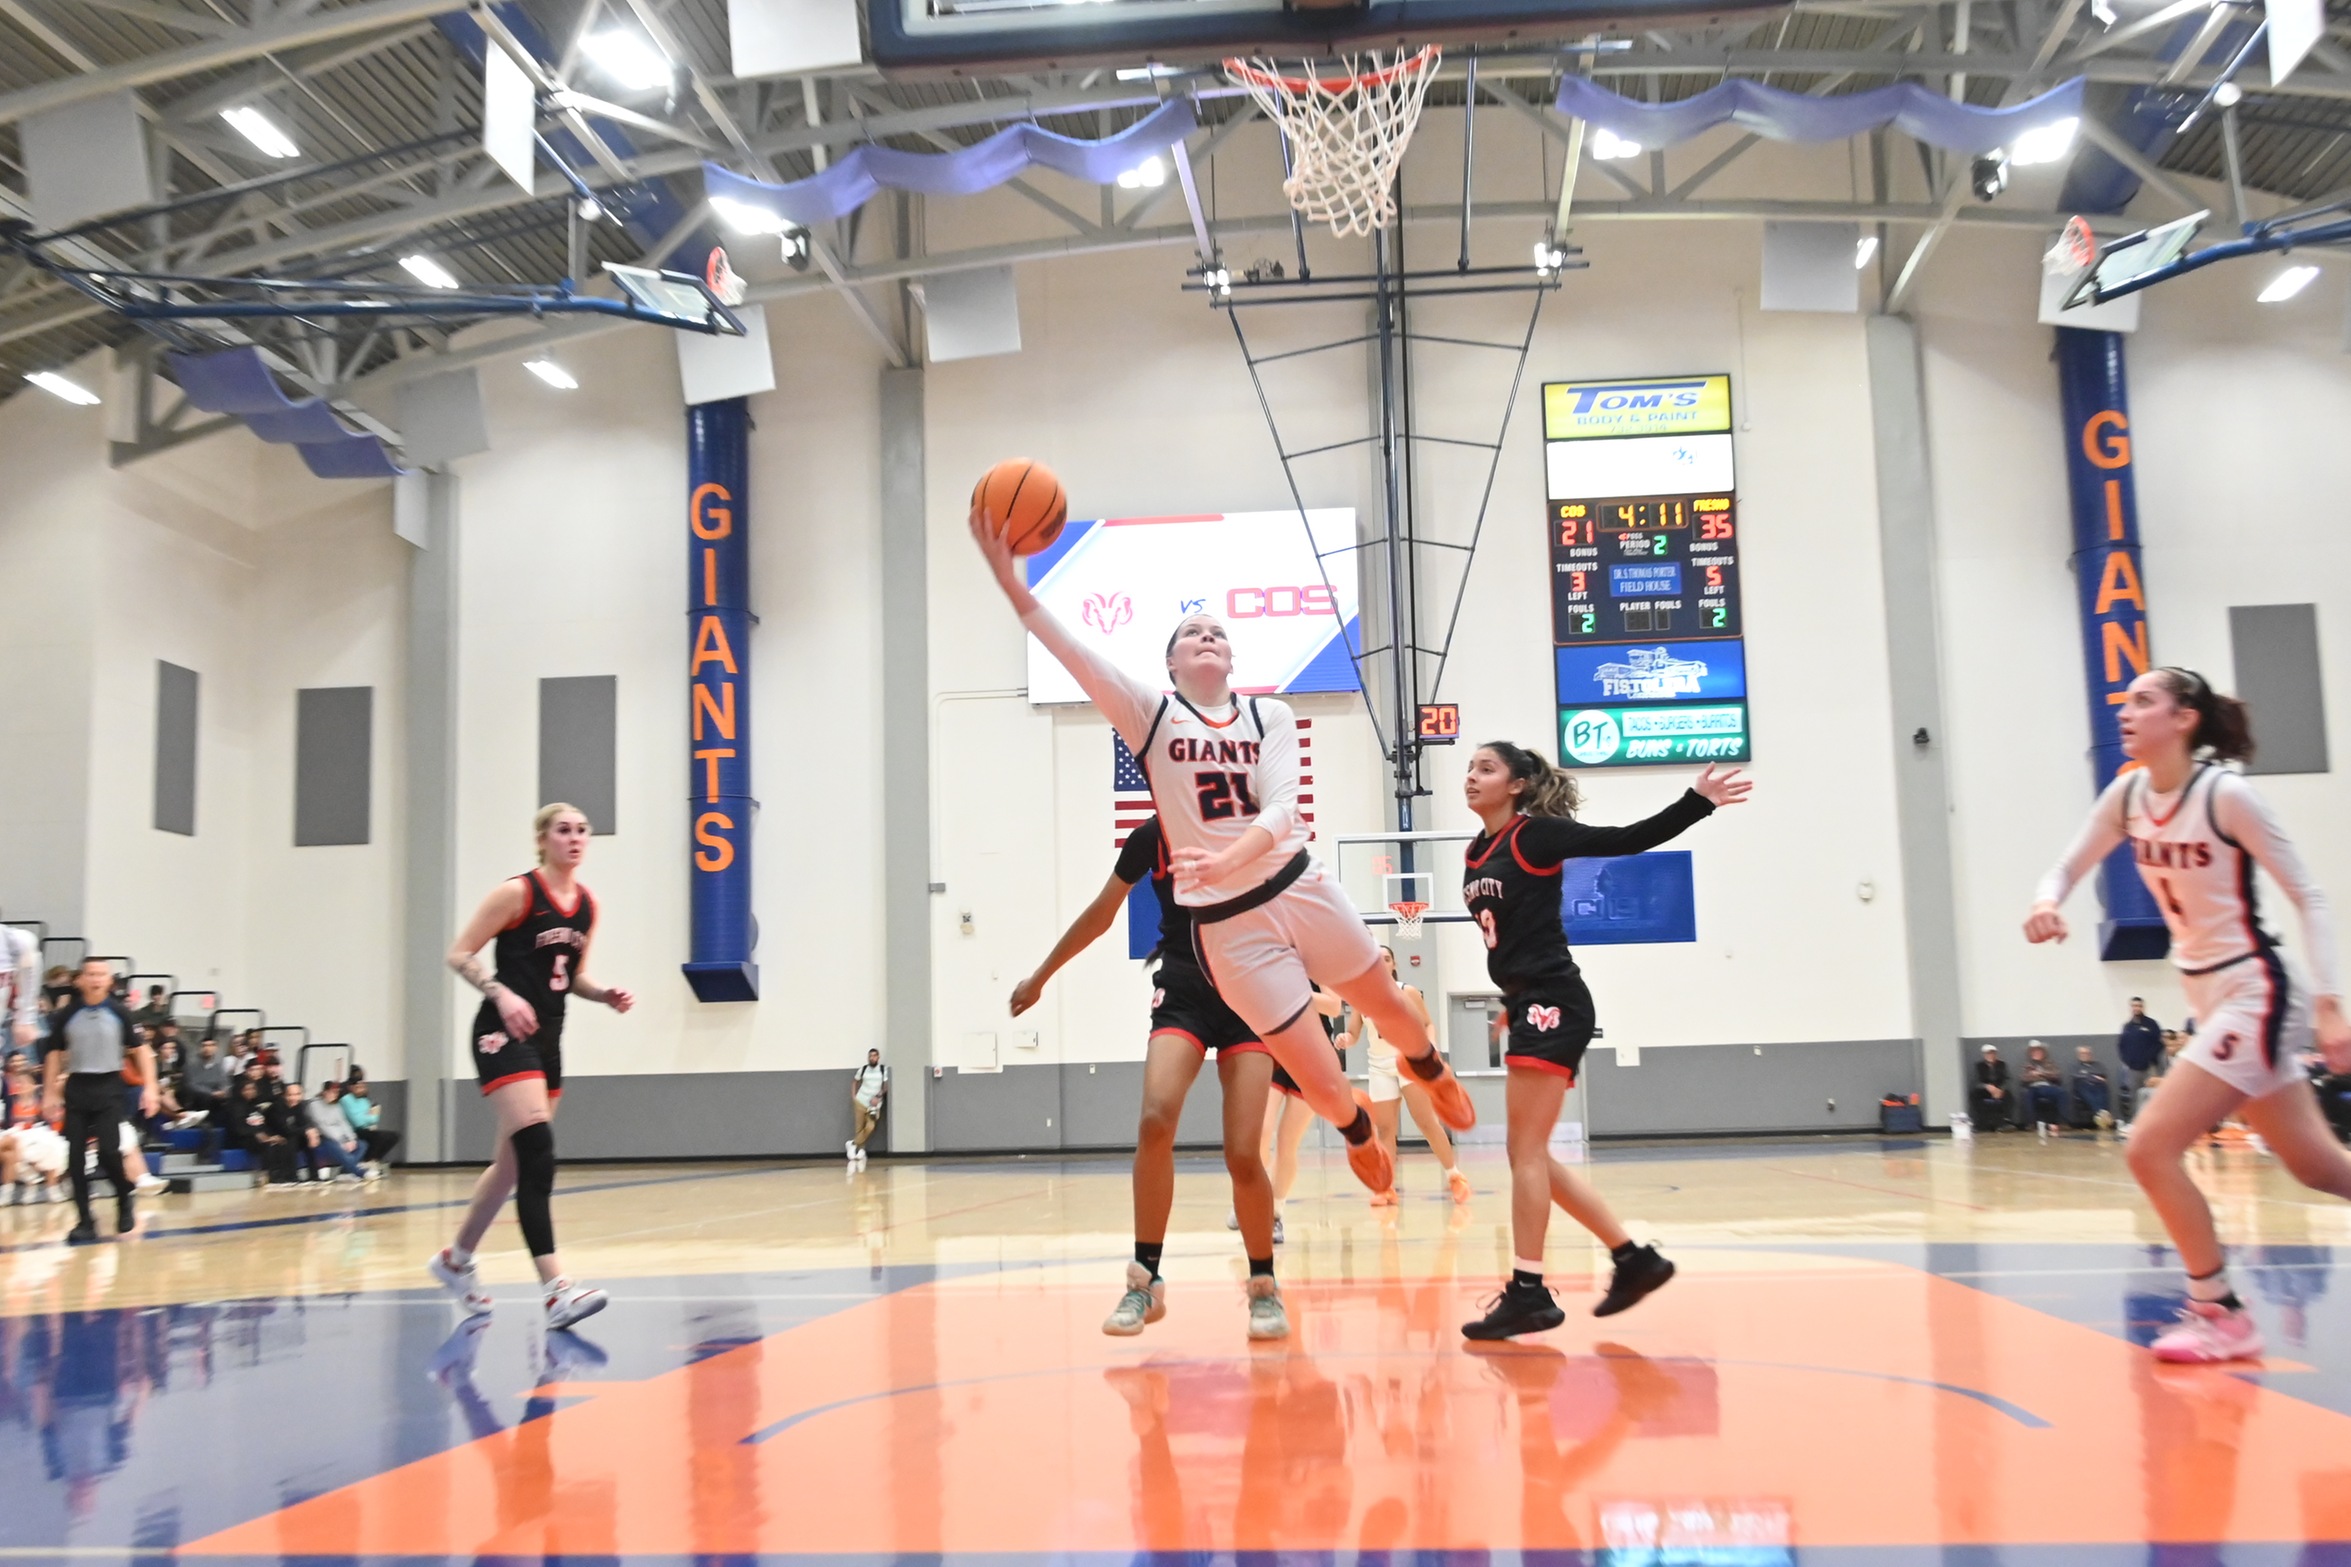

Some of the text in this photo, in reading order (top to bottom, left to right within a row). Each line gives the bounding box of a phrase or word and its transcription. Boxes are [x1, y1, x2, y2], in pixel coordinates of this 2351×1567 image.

[1566, 380, 1707, 414] TOM'S
[1577, 414, 1623, 425] BODY
[1647, 410, 1698, 422] PAINT
[1560, 505, 1586, 518] COS
[1618, 502, 1683, 528] 4:11
[1561, 520, 1594, 546] 21
[1700, 513, 1733, 539] 35
[1569, 547, 1598, 557] BONUS
[1619, 539, 1650, 550] PERIOD
[1653, 535, 1667, 555] 2
[1689, 541, 1718, 552] BONUS
[1556, 562, 1598, 573] TIMEOUTS
[1691, 556, 1734, 567] TIMEOUTS
[1571, 571, 1586, 592] 3
[1706, 565, 1722, 586] 5
[1568, 592, 1587, 601] LEFT
[1620, 581, 1644, 593] FIELD
[1704, 586, 1725, 595] LEFT
[2082, 409, 2150, 776] GIAN
[1226, 584, 1339, 619] COS
[1568, 604, 1595, 613] FOULS
[1619, 600, 1682, 611] PLAYER FOULS
[1698, 598, 1726, 608] FOULS
[1581, 613, 1596, 633] 2
[1712, 608, 1727, 628] 2
[690, 482, 738, 872] GIANTS
[1421, 707, 1457, 735] 20
[1625, 738, 1672, 759] BUNS
[1686, 737, 1743, 758] TORTS
